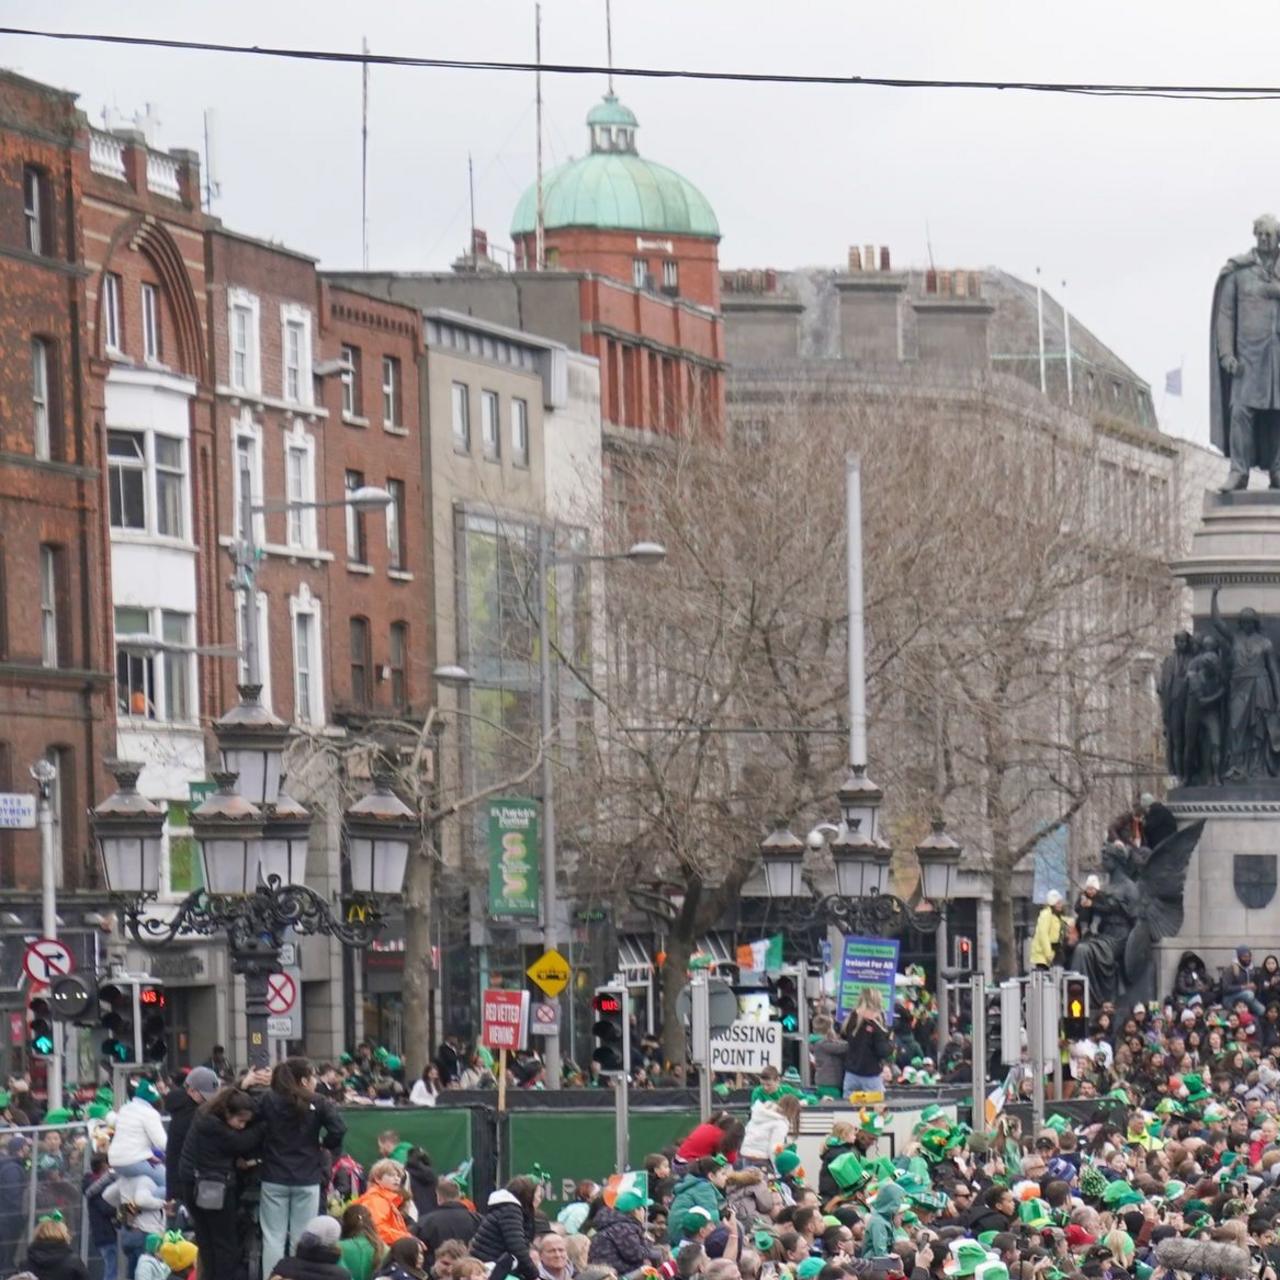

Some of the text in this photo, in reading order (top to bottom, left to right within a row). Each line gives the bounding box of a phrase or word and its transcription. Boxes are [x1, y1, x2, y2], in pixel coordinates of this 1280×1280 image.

[845, 958, 870, 969] Ireland
[871, 959, 882, 969] For
[601, 1000, 618, 1011] BUS
[713, 1049, 770, 1066] POINT H
